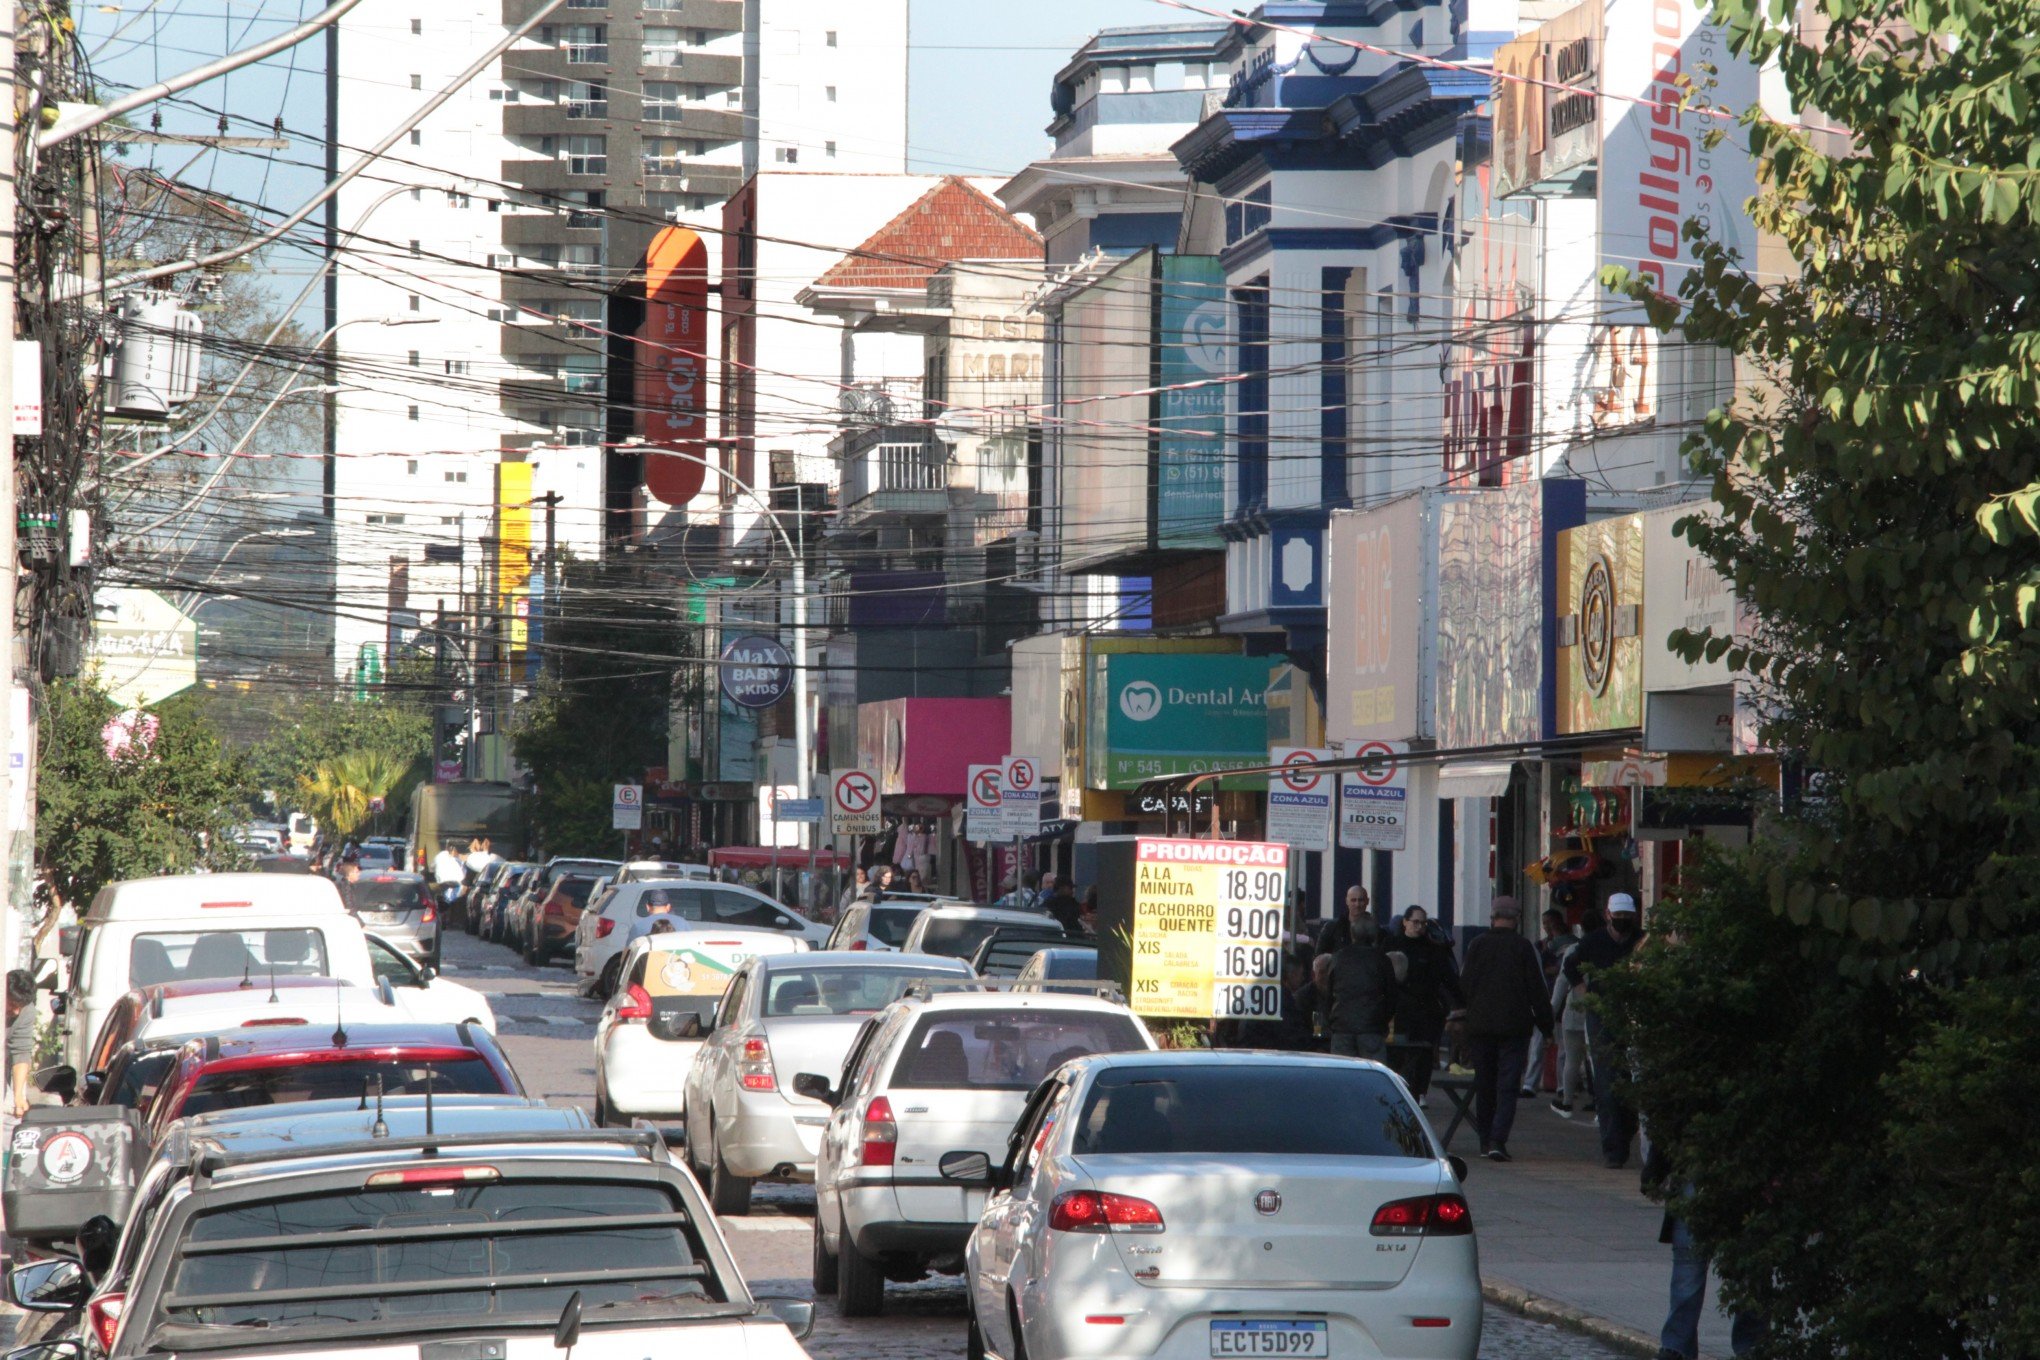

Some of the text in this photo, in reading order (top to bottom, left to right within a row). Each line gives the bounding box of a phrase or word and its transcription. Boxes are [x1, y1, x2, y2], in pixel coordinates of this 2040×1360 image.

[1185, 465, 1209, 481] (51)
[1355, 525, 1392, 675] BIG
[733, 667, 779, 681] BABY
[1168, 687, 1233, 705] Dental
[1138, 760, 1161, 774] 545
[1003, 791, 1038, 799] ZONA AZUL
[1273, 795, 1327, 805] ZONA AZUL
[1346, 787, 1403, 798] ZONA AZUL
[1349, 814, 1398, 825] IDOSO
[846, 824, 877, 832] ÔNIBUS
[1140, 842, 1284, 864] PROMOÇÃO
[1140, 881, 1194, 896] MINUTA
[1154, 867, 1171, 880] LA
[1226, 870, 1282, 902] 18,90
[1138, 902, 1281, 940] CACHORRO 9,00
[1159, 917, 1214, 932] QUENTE
[1137, 941, 1161, 954] XIS
[1223, 946, 1281, 978] 16,90
[1136, 979, 1159, 993] XIS
[1223, 985, 1281, 1016] 18,90
[1260, 1195, 1276, 1209] FIAT
[1220, 1331, 1315, 1353] ECT5D99
